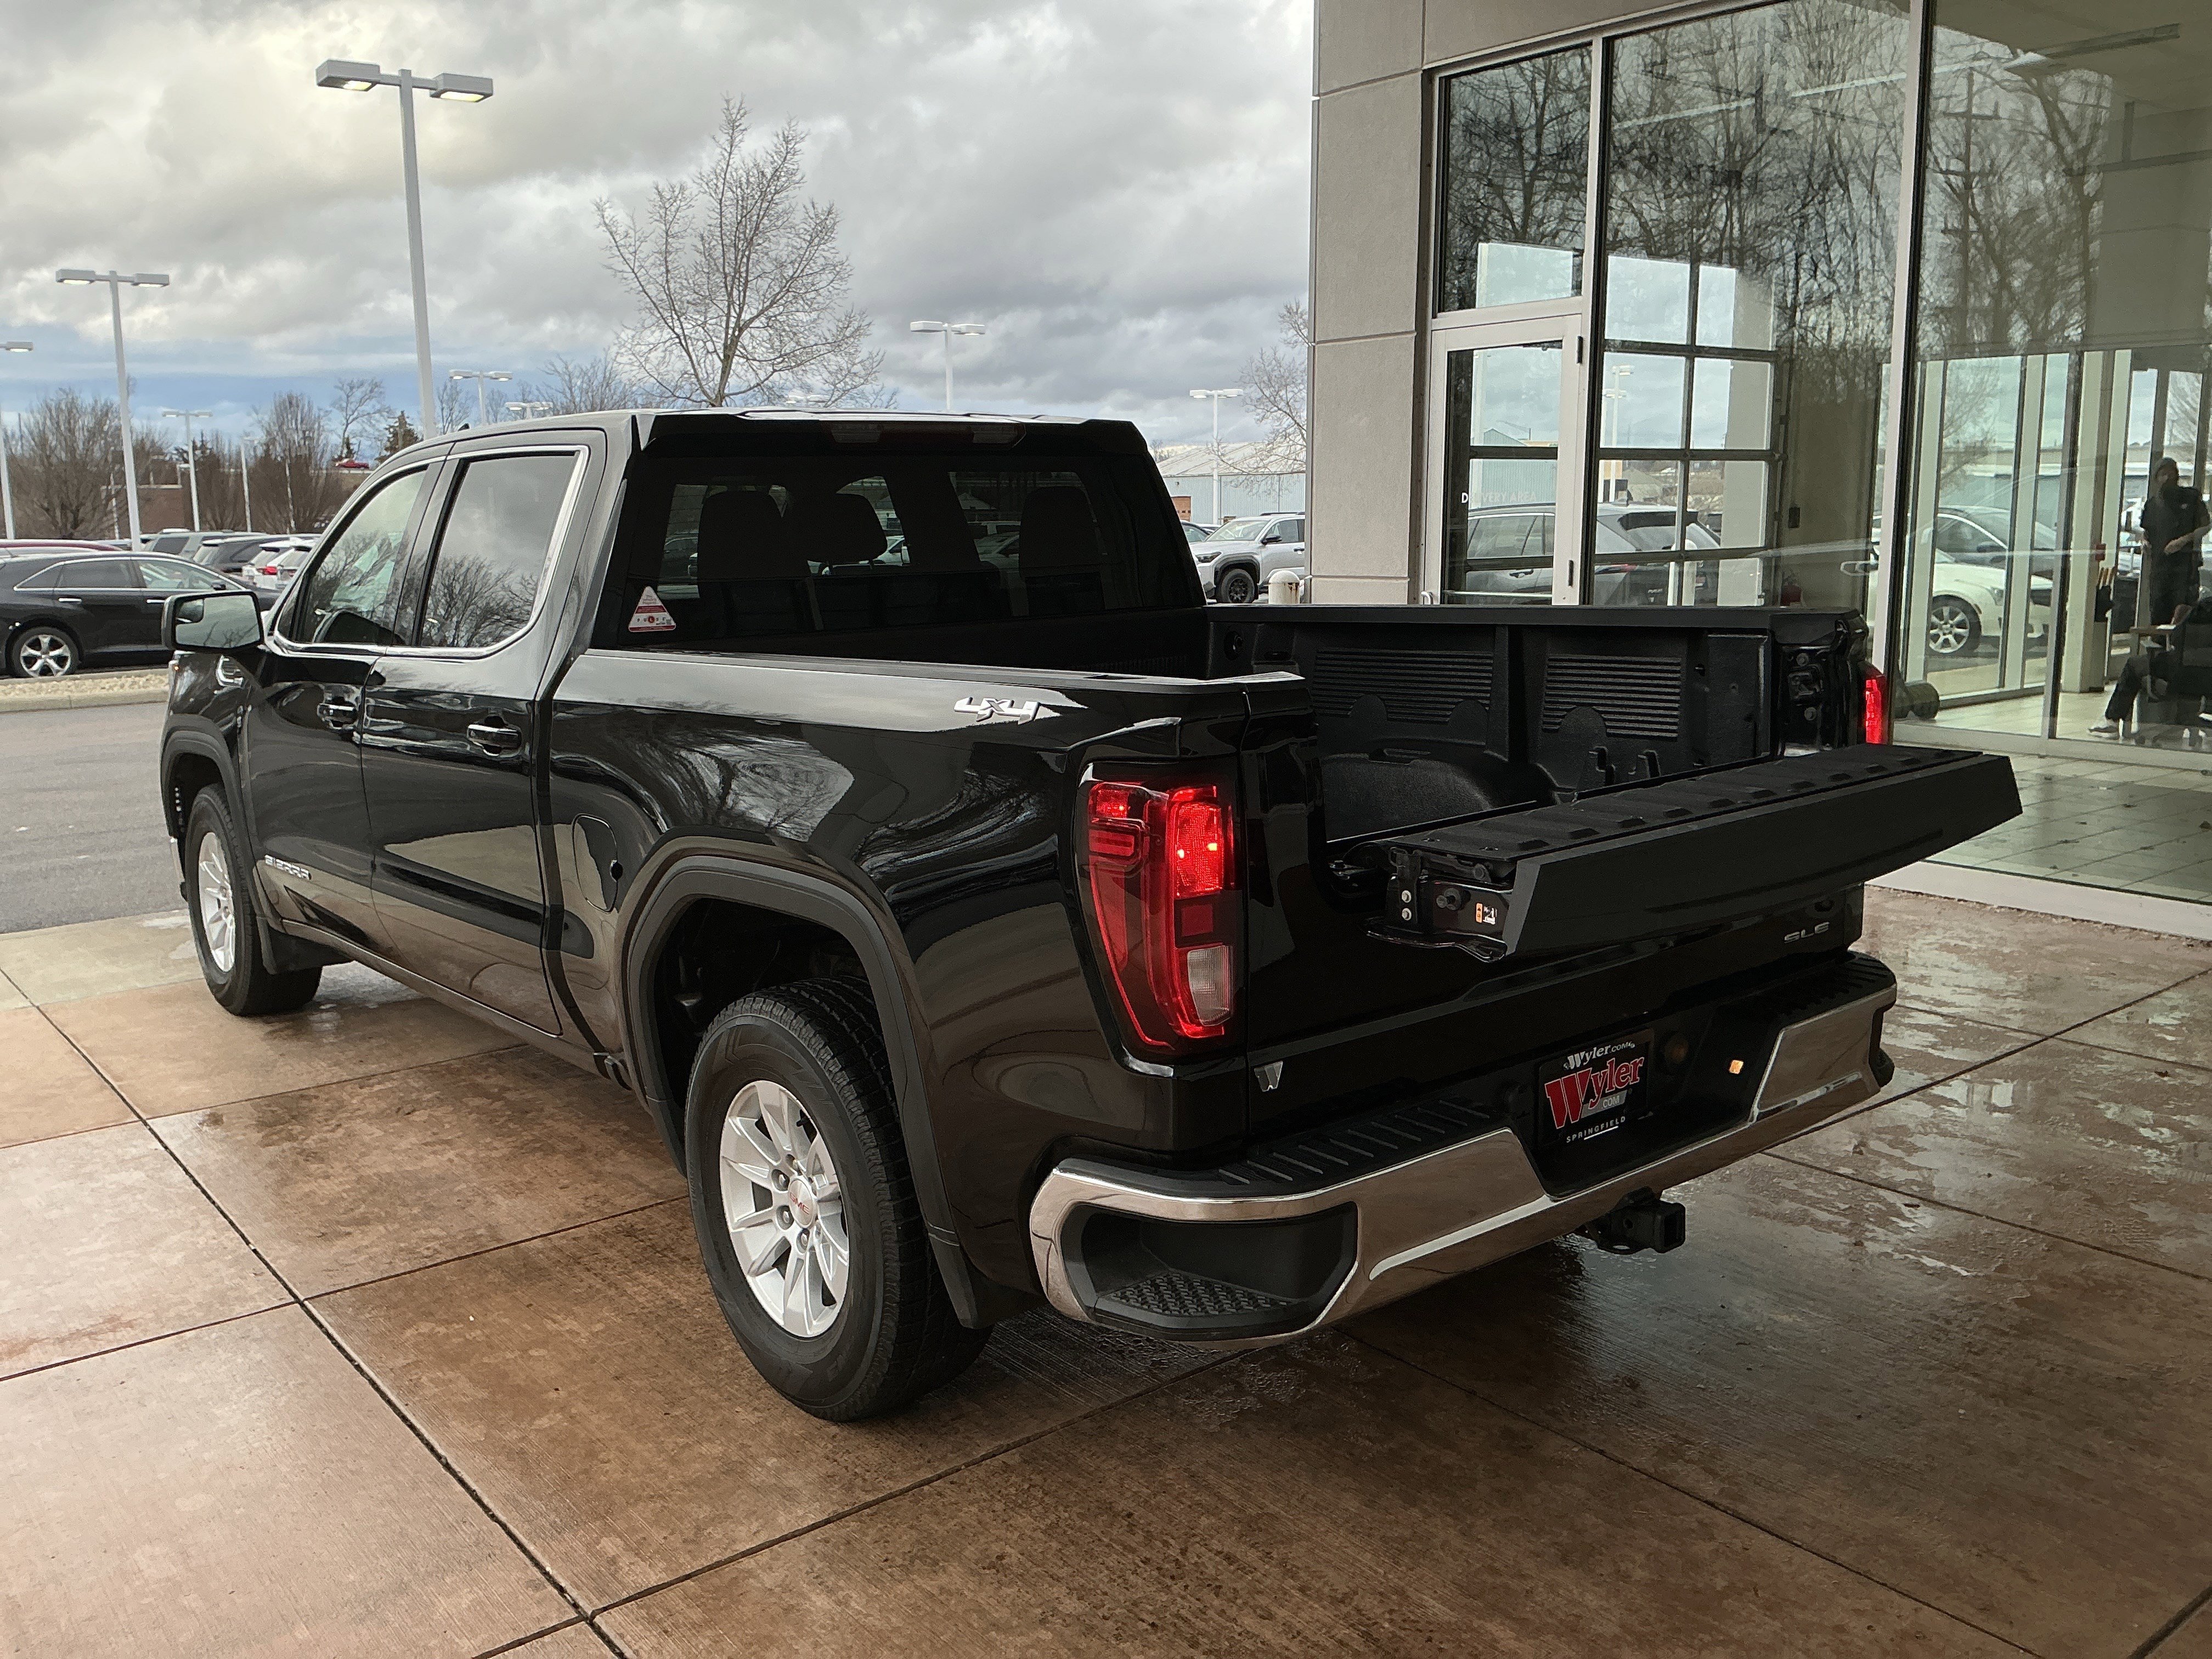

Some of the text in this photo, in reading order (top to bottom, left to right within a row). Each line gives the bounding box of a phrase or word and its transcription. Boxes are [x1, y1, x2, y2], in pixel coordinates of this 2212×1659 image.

[953, 697, 1041, 725] 4X4
[1784, 922, 1830, 944] SLE
[1544, 1057, 1645, 1130] Wyler
[1566, 1116, 1626, 1143] SPRINGFIELD
[790, 1192, 810, 1215] GMC
